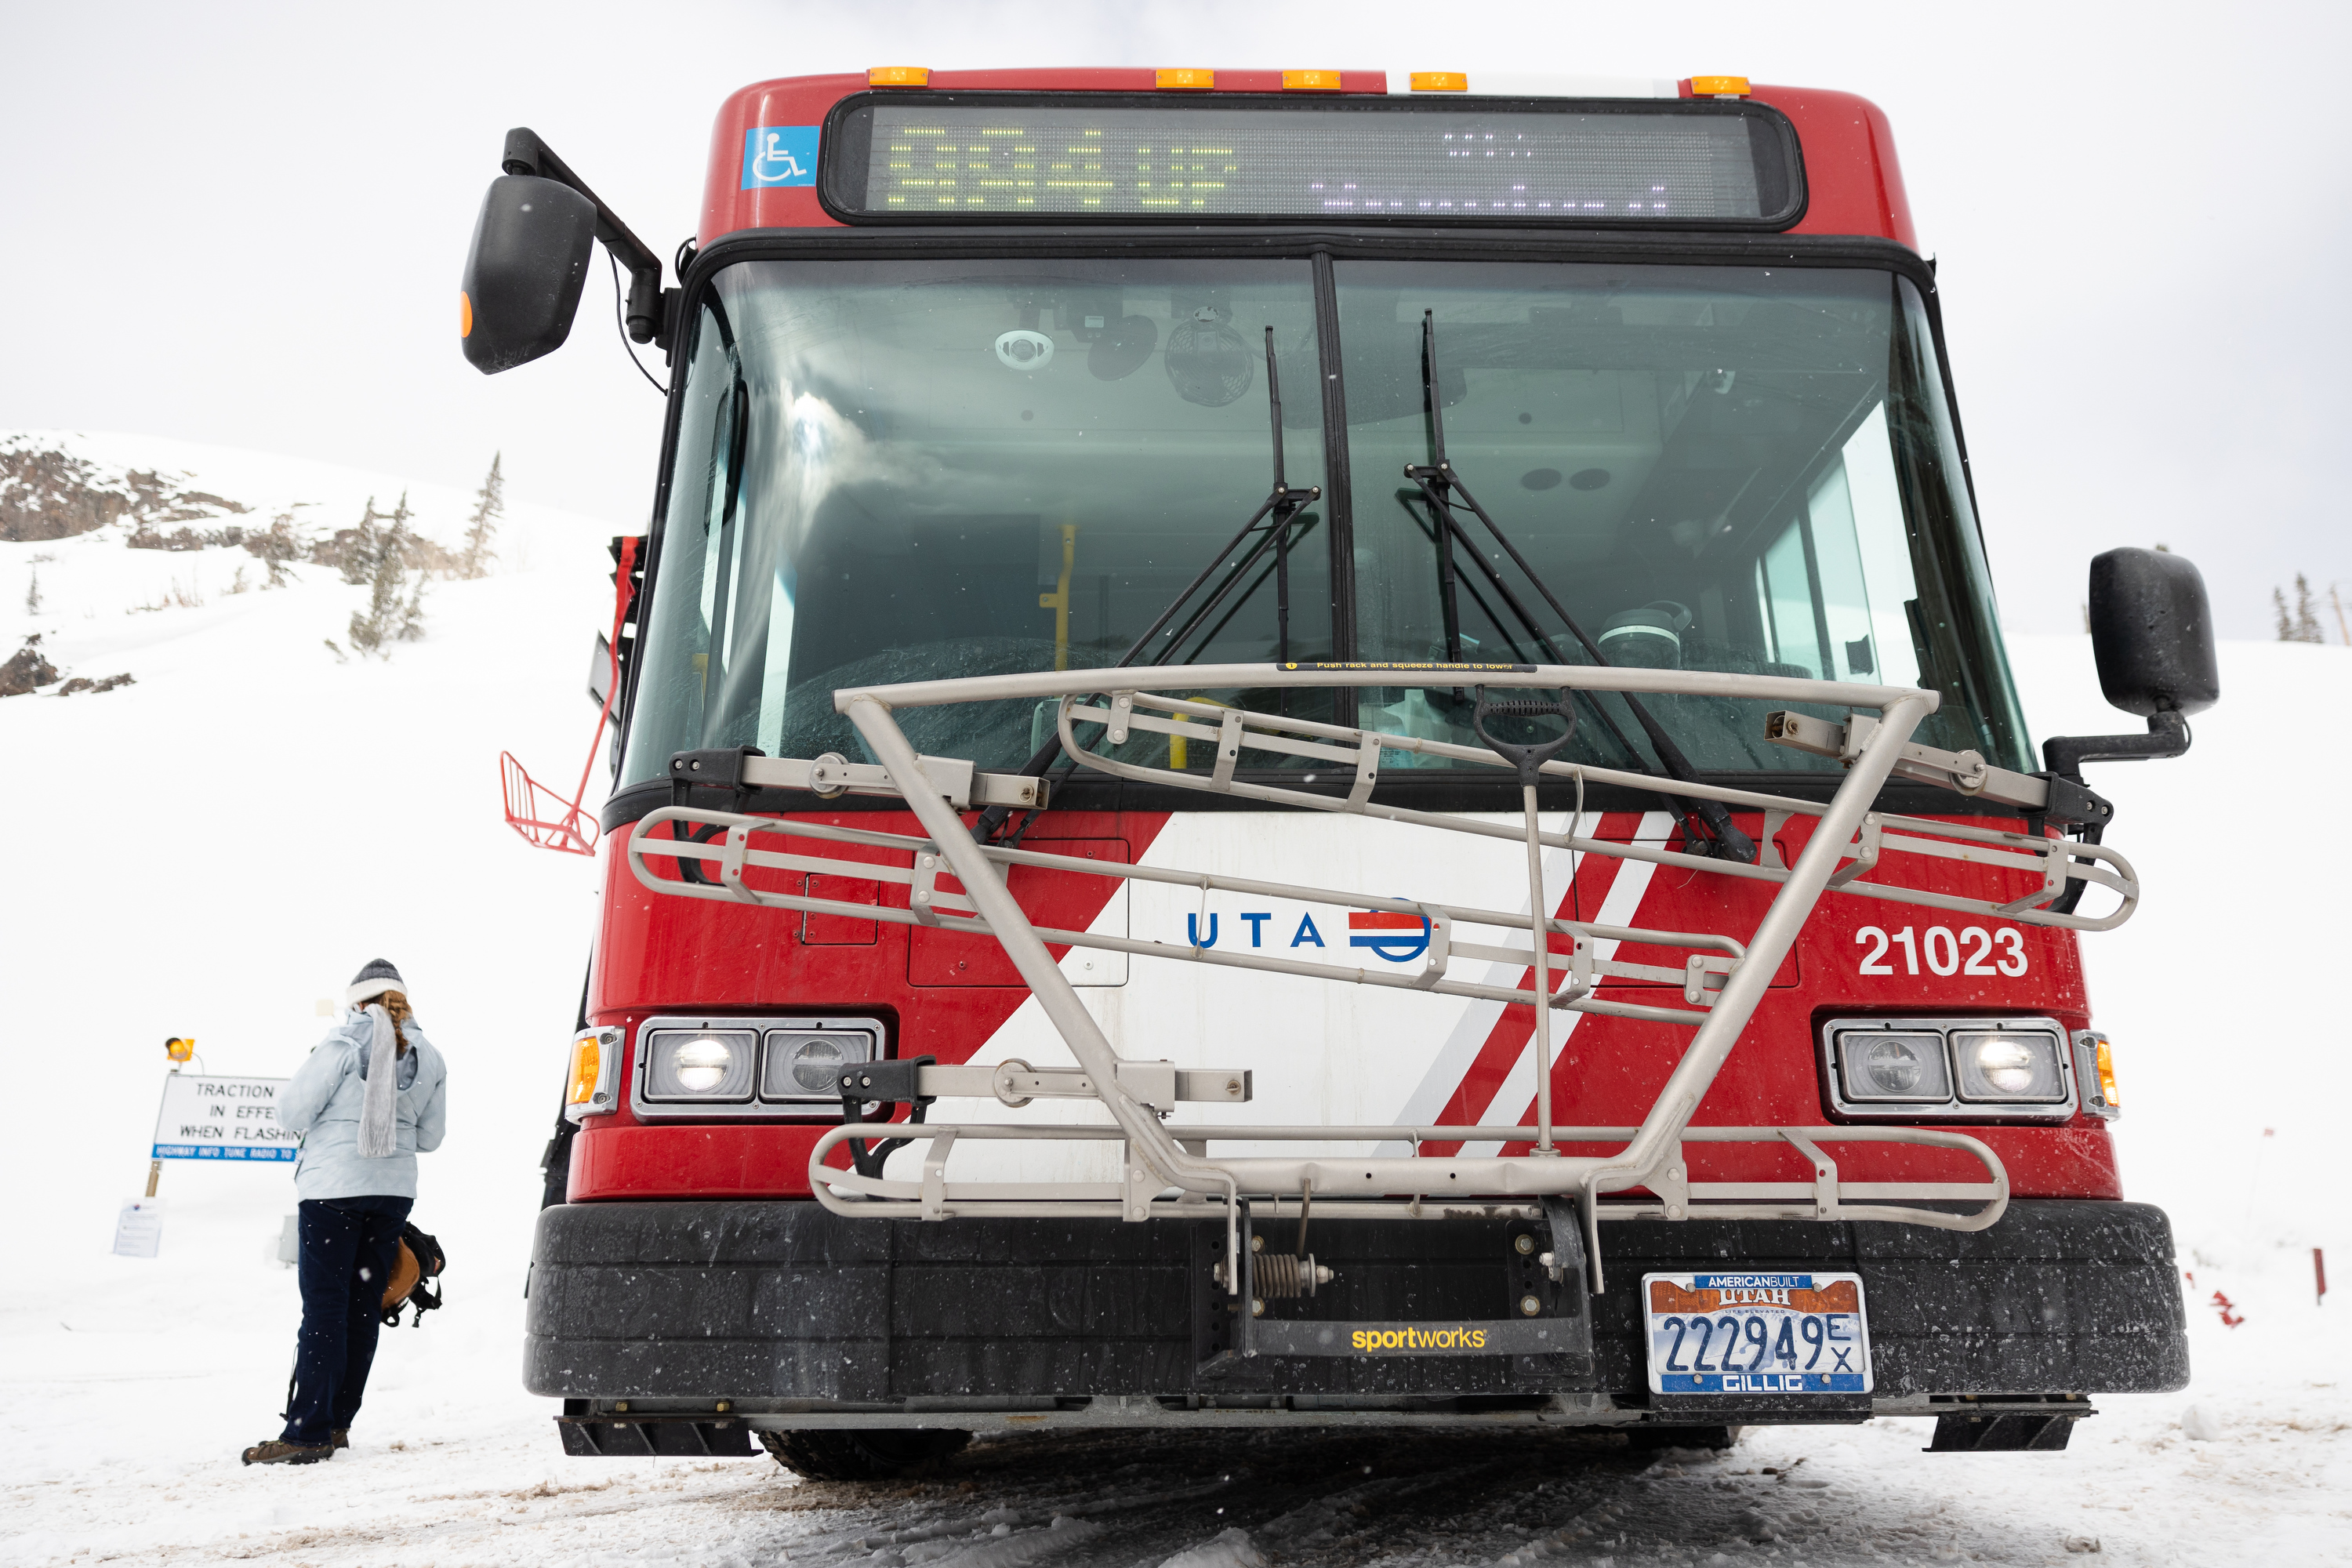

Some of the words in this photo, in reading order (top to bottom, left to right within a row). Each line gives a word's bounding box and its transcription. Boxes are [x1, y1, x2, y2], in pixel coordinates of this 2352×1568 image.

[1188, 911, 1326, 949] UTA
[1855, 926, 2028, 977] 21023
[197, 1083, 274, 1098] TRACTION
[209, 1105, 225, 1116] IN
[237, 1105, 275, 1120] EFFE
[180, 1125, 224, 1138] WHEN
[234, 1126, 301, 1141] FLASHIN
[156, 1145, 196, 1157] HIGHWAY
[198, 1147, 220, 1157] INFO
[223, 1147, 247, 1158] TUNE
[249, 1148, 277, 1159] RADIO
[281, 1149, 293, 1160] TO
[1719, 1289, 1791, 1306] UTAH
[1352, 1327, 1486, 1352] sportworks
[1664, 1316, 1824, 1371] 222949
[1722, 1374, 1802, 1392] GILLIG
